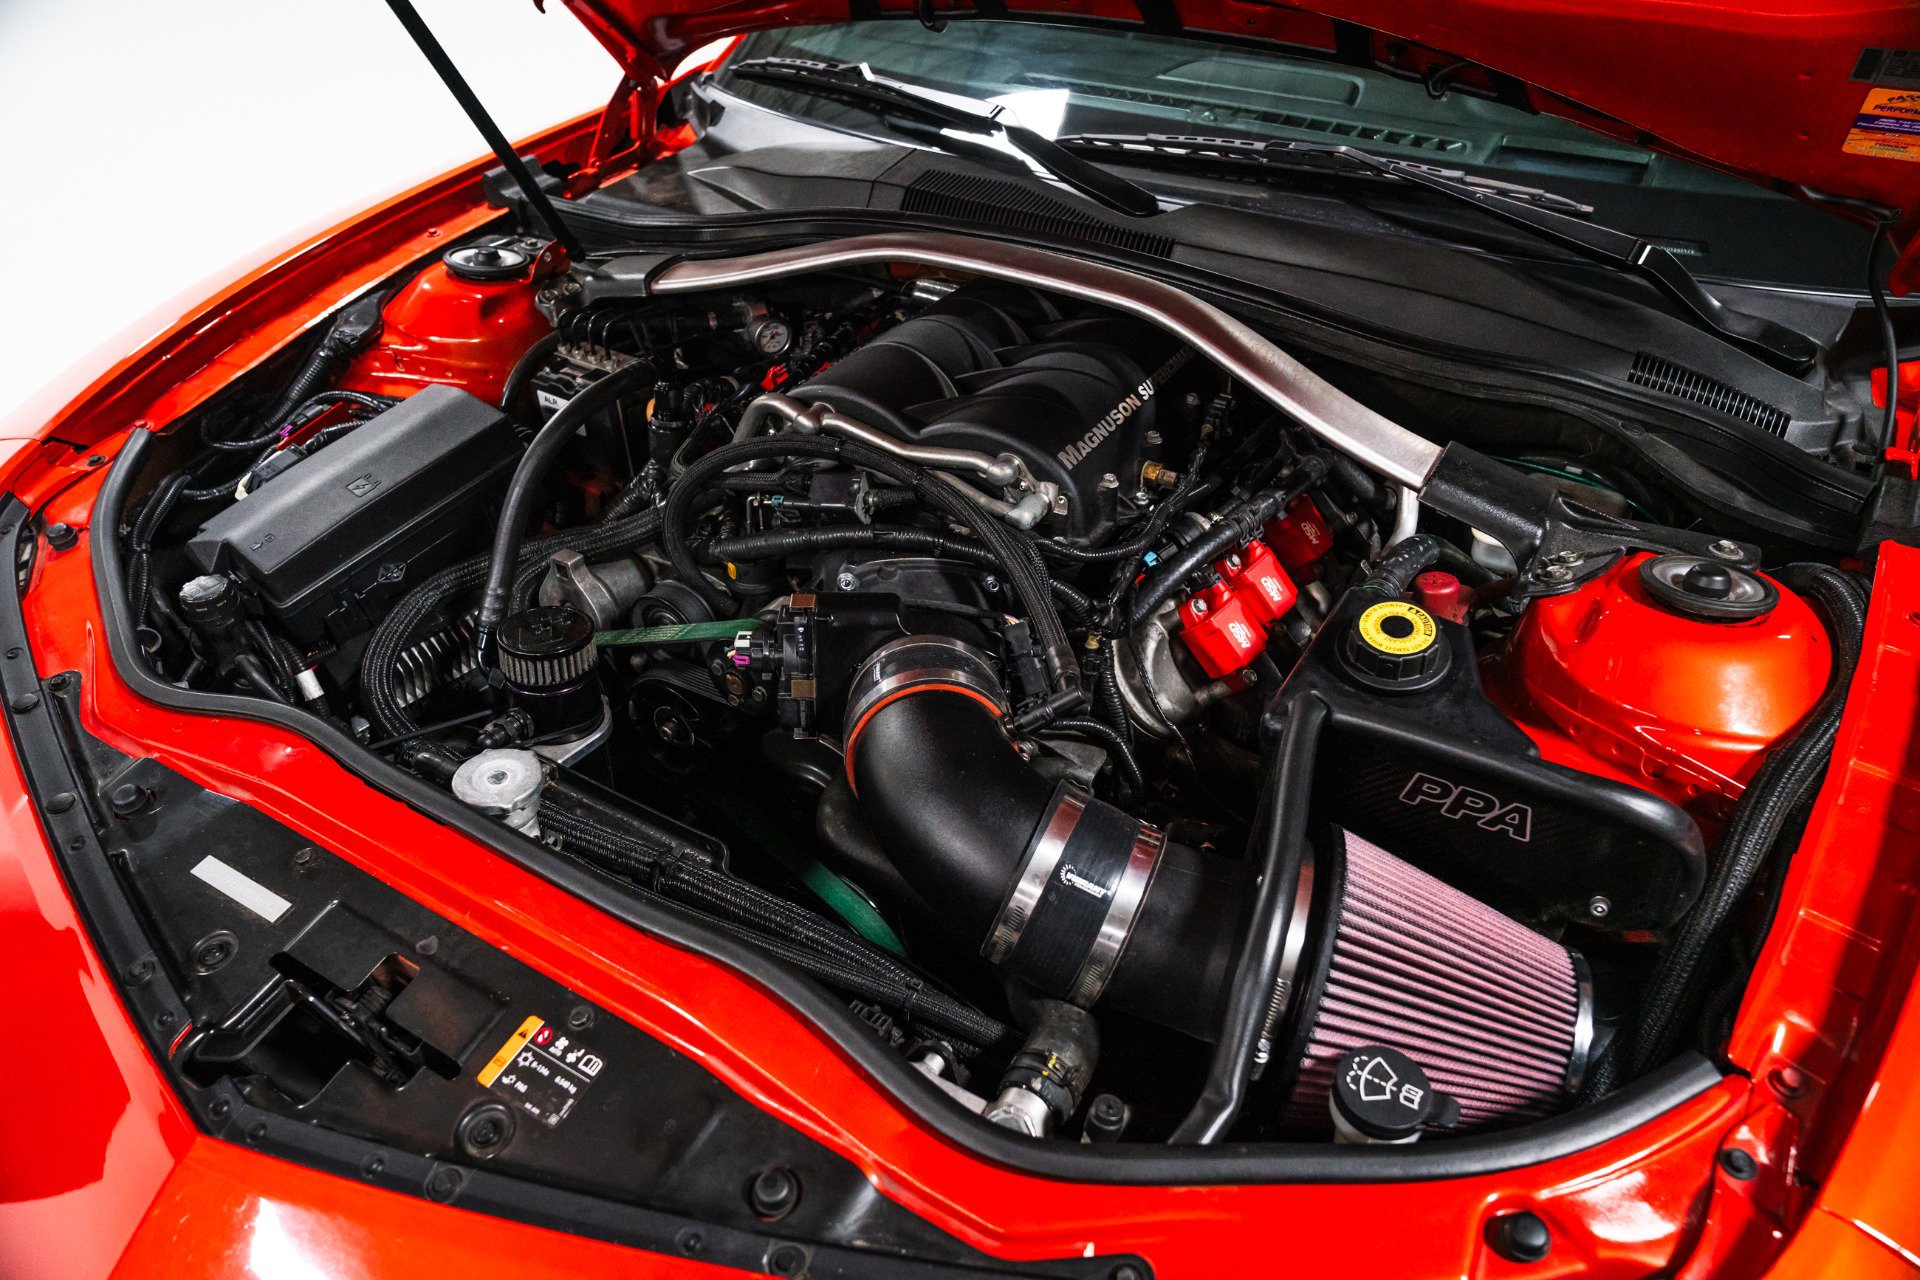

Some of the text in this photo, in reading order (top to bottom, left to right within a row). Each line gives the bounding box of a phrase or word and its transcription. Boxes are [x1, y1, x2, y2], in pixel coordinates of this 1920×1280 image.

[1057, 394, 1142, 470] MAGNUSON
[1300, 521, 1320, 545] MSD
[1261, 575, 1282, 601] MSD
[1228, 621, 1251, 648] MSD
[1399, 772, 1532, 842] PPA
